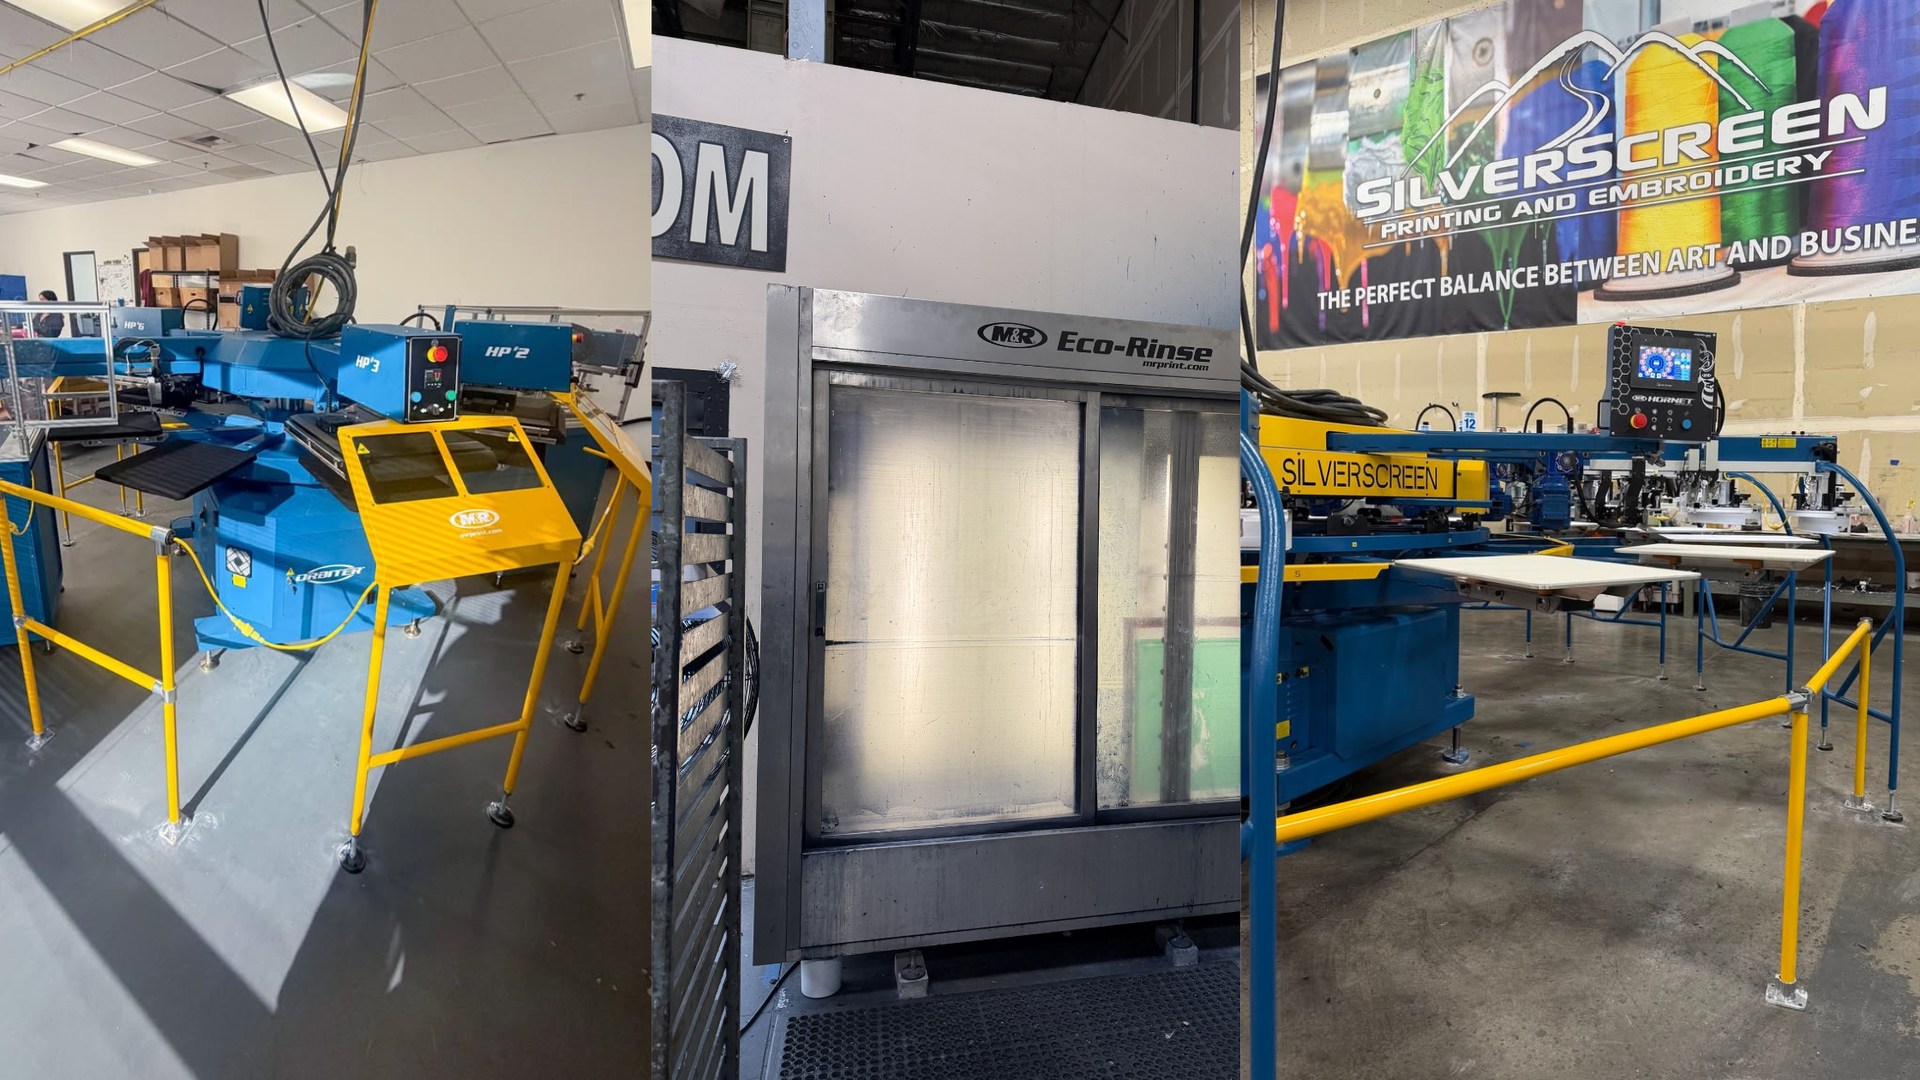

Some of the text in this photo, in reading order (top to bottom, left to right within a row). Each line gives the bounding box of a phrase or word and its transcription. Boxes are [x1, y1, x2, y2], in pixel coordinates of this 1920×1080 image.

[1356, 85, 1887, 218] SILVERSCREEN
[1380, 150, 1833, 239] PRINTING AND EMBROIDERY
[1317, 217, 1917, 311] THE PERFECT BALANCE BETWEEN ART AND BUSINE
[991, 325, 1213, 363] M&R Eco-Rinse
[1142, 360, 1209, 371] mrprint.com
[1648, 396, 1694, 404] HORNET
[1464, 418, 1476, 429] 12
[1281, 457, 1438, 491] SILVERSCREEN
[296, 565, 365, 583] ORBITER
